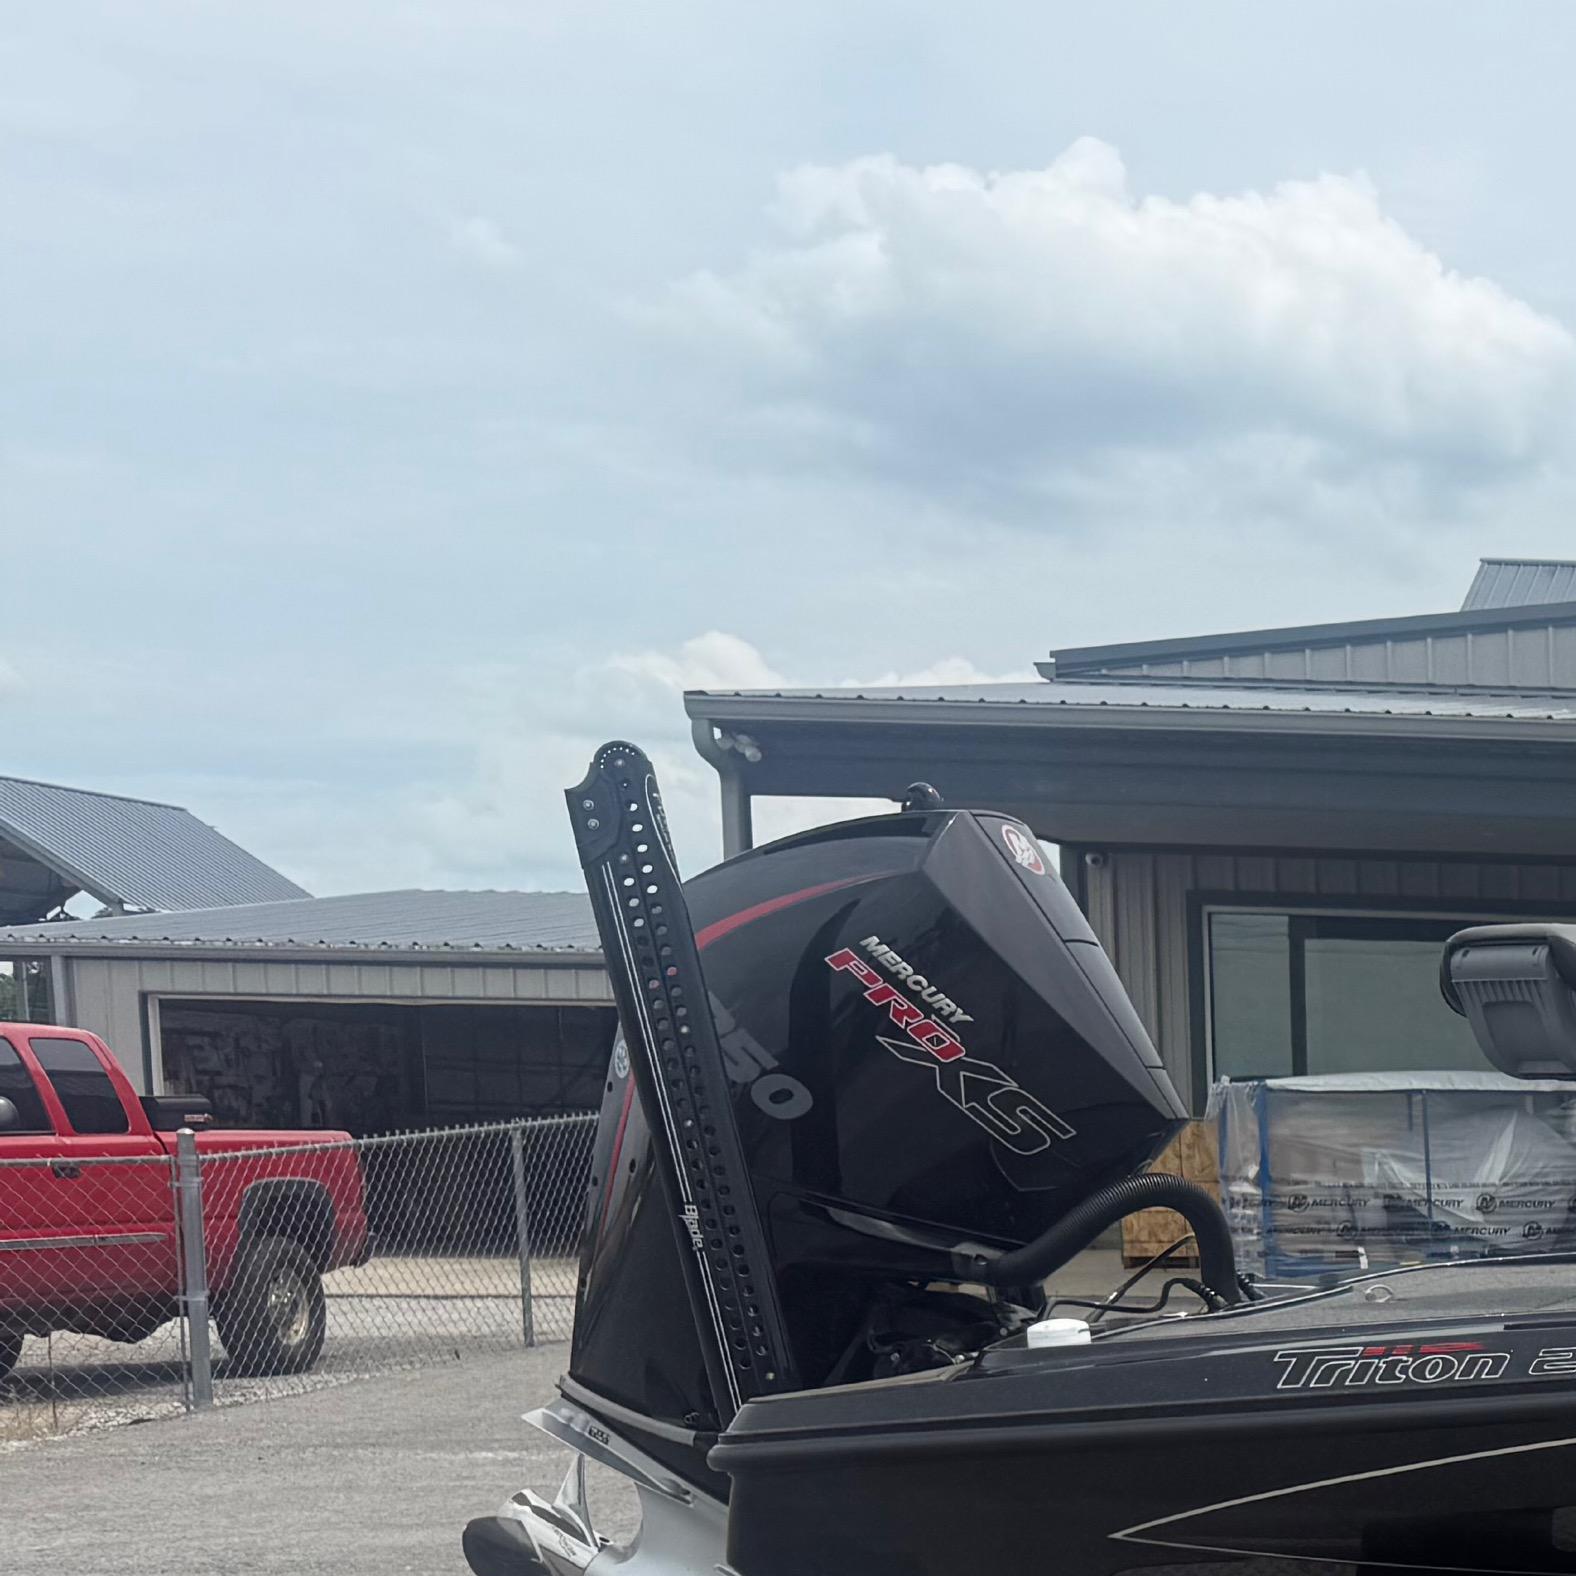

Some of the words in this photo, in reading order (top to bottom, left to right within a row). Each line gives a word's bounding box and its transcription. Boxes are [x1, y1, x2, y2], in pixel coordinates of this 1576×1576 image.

[824, 947, 966, 1062] PRO
[859, 935, 974, 1024] MERCURY
[875, 1014, 1077, 1155] XS
[1453, 1226, 1512, 1236] MERCURY
[1498, 1199, 1556, 1209] MERCURY
[1273, 1345, 1511, 1389] Triton
